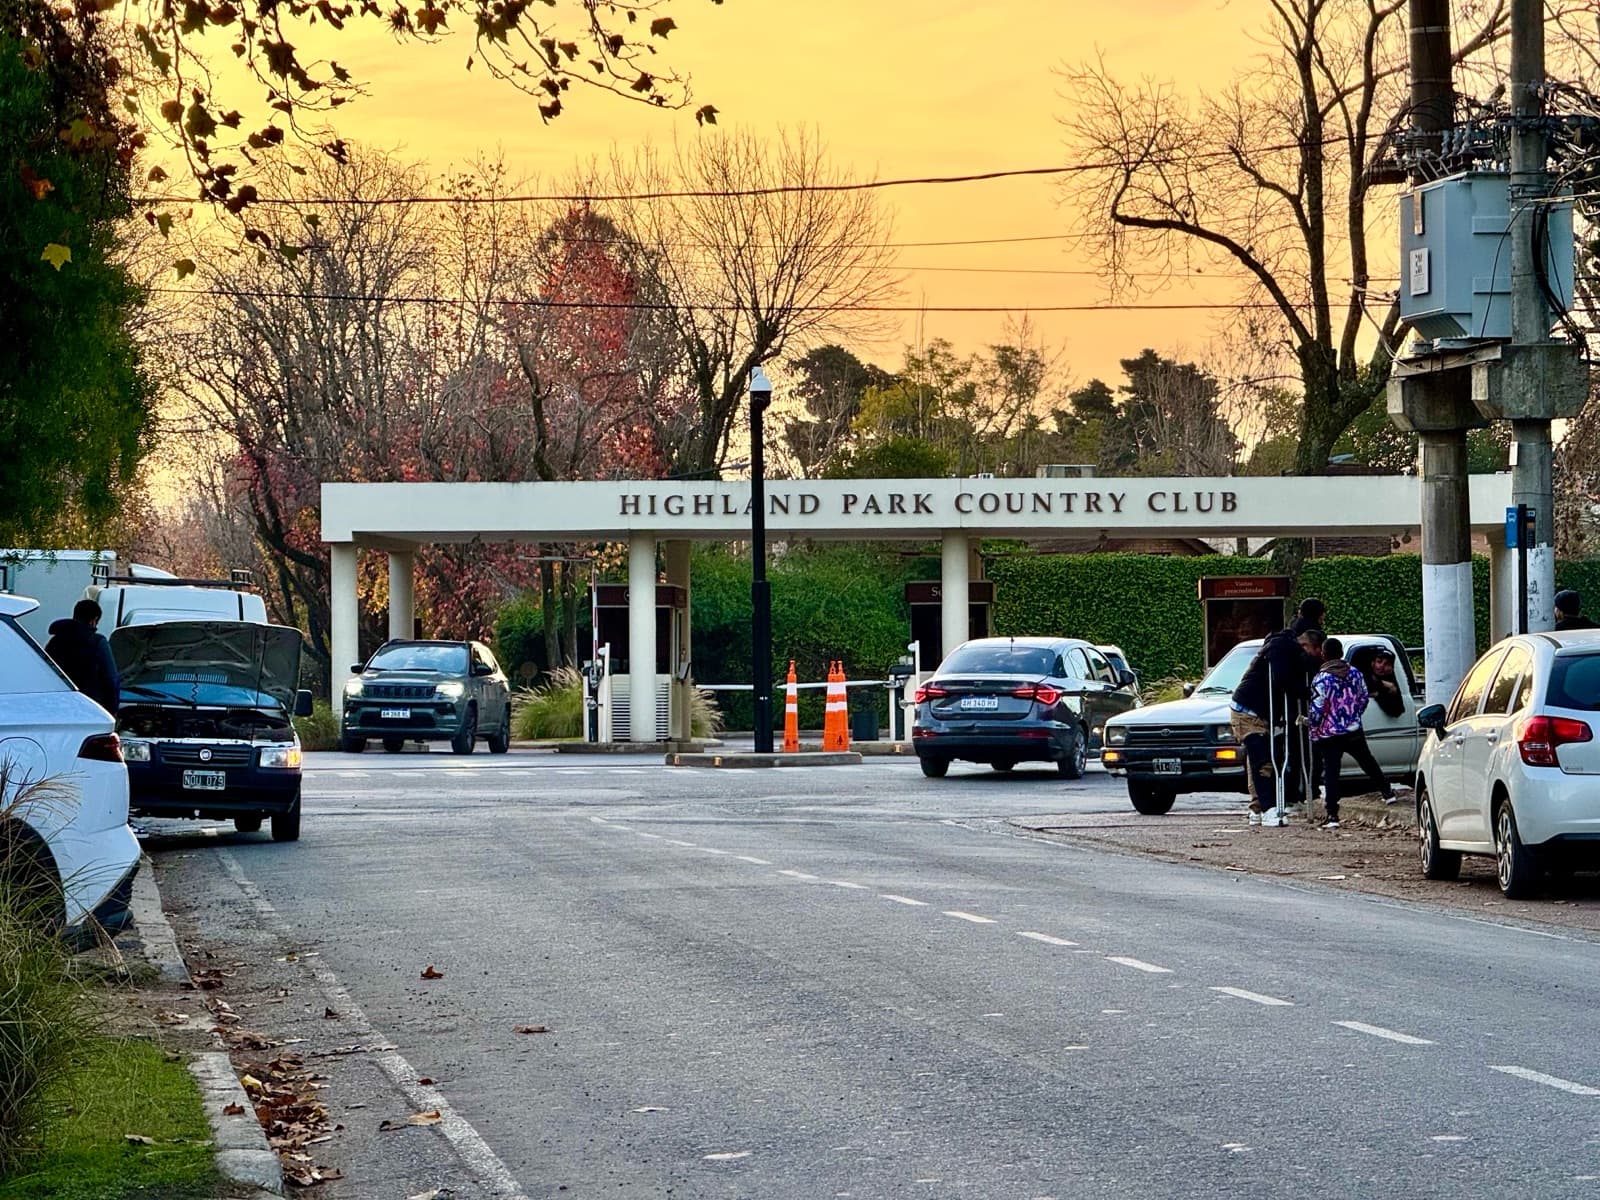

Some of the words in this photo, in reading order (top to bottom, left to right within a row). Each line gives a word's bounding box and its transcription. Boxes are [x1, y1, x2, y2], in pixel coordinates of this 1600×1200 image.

[842, 493, 933, 515] PARK
[954, 492, 1126, 514] COUNTRY
[1148, 491, 1238, 513] CLUB
